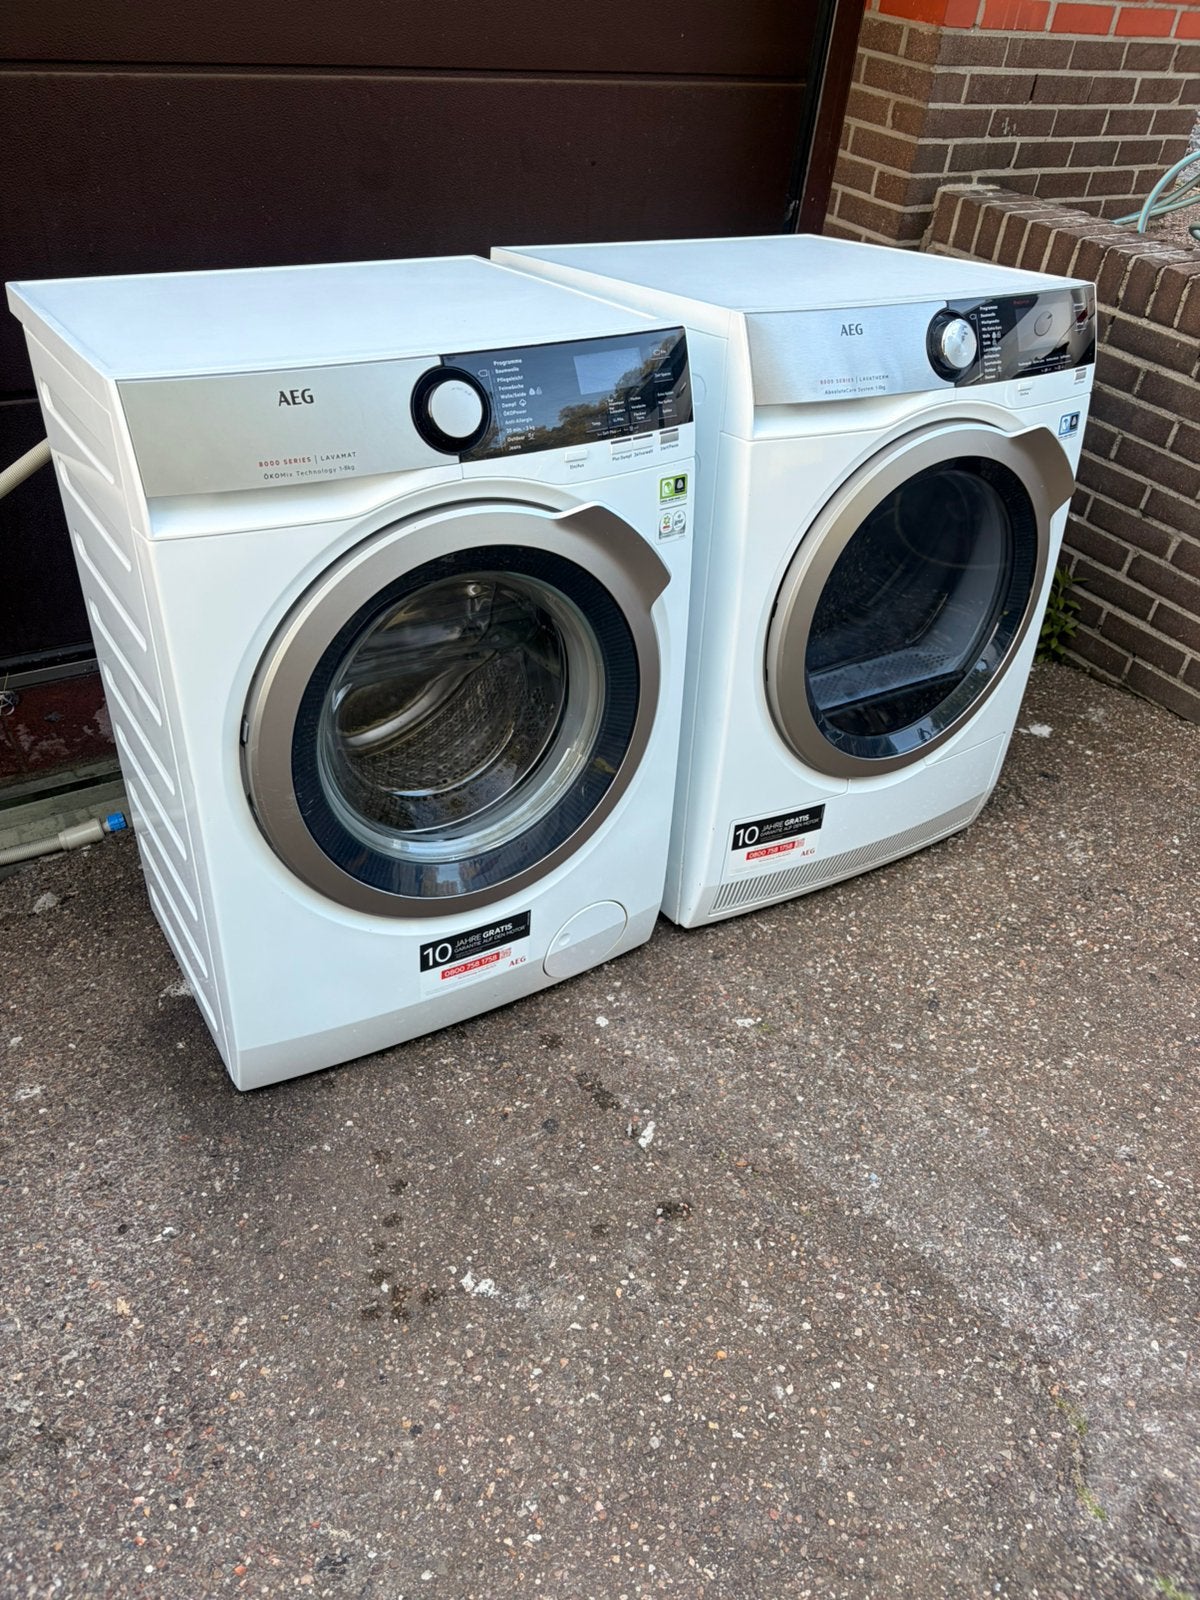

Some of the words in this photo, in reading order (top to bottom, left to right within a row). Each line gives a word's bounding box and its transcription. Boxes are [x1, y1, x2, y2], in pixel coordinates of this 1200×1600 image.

[840, 323, 864, 336] AEG
[493, 359, 523, 367] Programme
[497, 375, 524, 383] Pflegeleicht
[278, 388, 315, 407] AEG
[825, 387, 857, 395] AbsoluteCare
[507, 434, 526, 442] Outdoor
[258, 459, 280, 468] 8000
[283, 456, 312, 465] SERIES
[320, 451, 357, 462] LAVAMAT
[263, 471, 293, 480] ÖKOMix
[296, 466, 337, 477] Technology
[761, 820, 785, 832] JAHRE
[784, 814, 810, 826] GRATIS
[735, 825, 760, 847] 10
[760, 828, 783, 837] GARANTIE
[748, 849, 767, 859] 0800
[800, 848, 816, 857] AEG
[455, 933, 482, 948] JAHRE
[482, 922, 513, 938] GRATIS
[454, 940, 482, 953] GARANTIE
[482, 937, 493, 945] AUF
[494, 932, 506, 941] DEN
[423, 942, 453, 967] 10
[444, 966, 466, 977] 0800
[466, 960, 480, 971] 758
[481, 954, 498, 966] 1758
[508, 956, 527, 968] AEG
